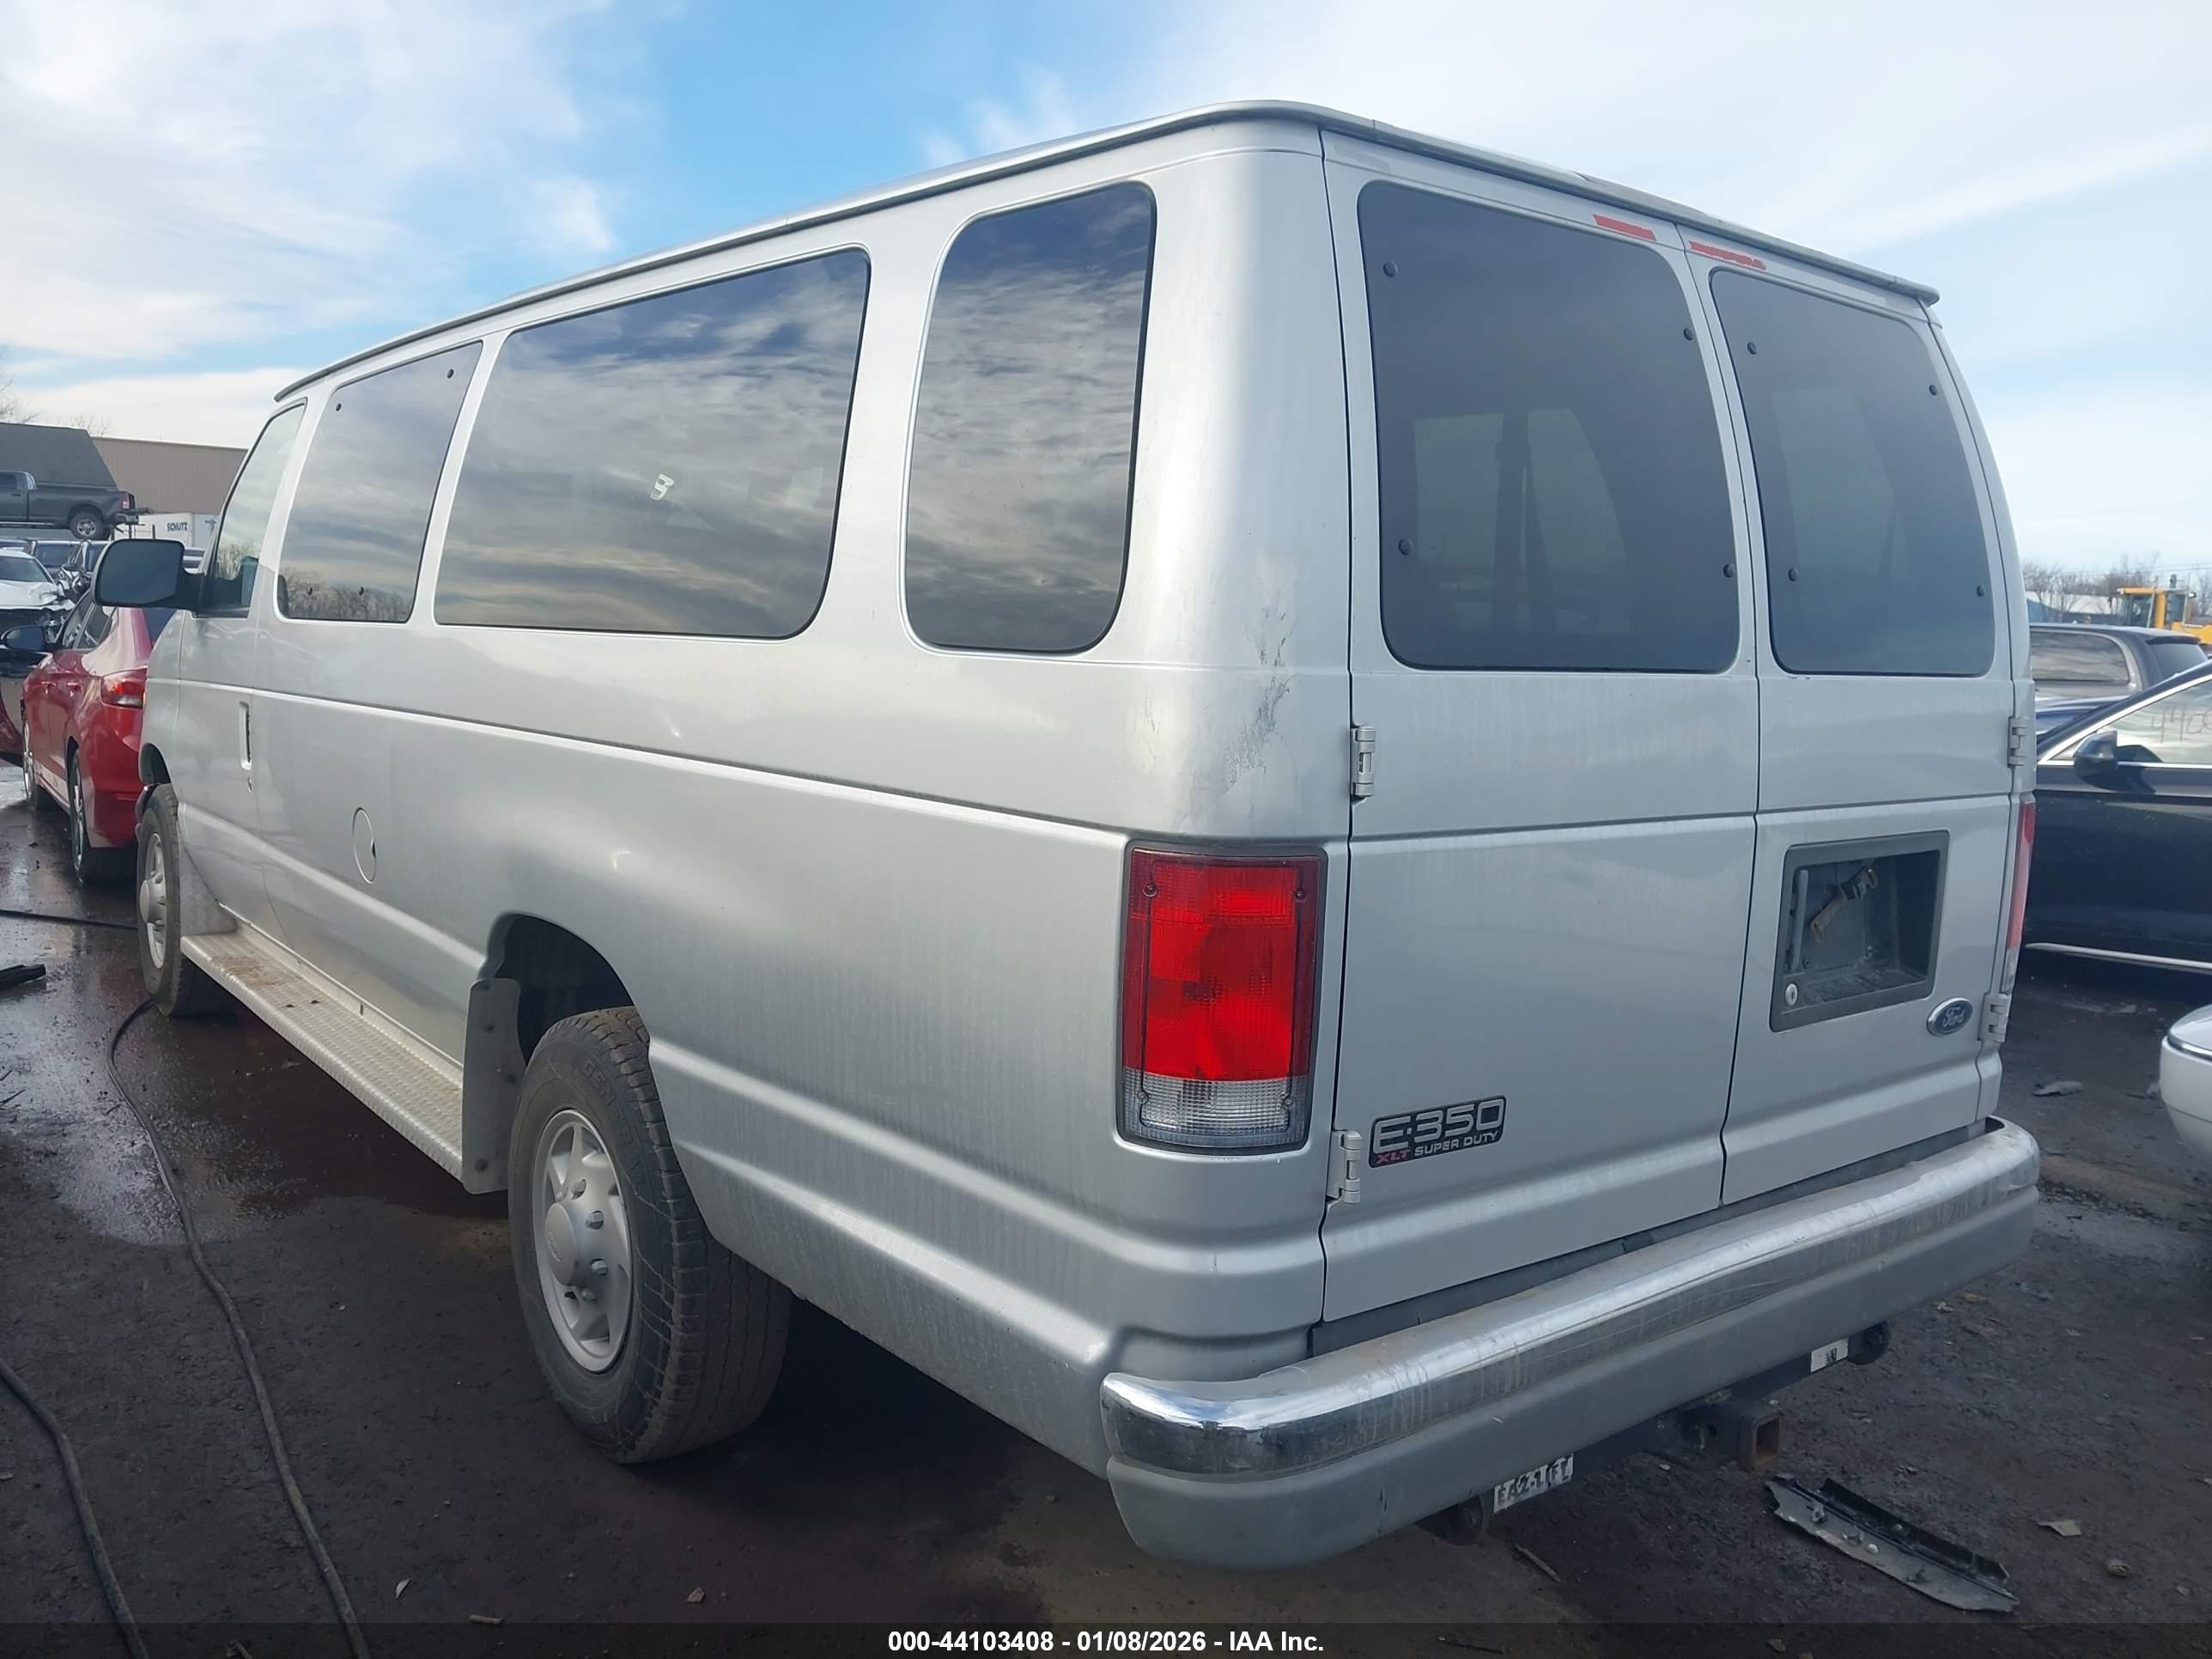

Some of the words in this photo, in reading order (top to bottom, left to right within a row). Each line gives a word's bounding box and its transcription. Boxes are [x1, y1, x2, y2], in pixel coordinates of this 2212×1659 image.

[1942, 1006, 1966, 1028] Ford
[1373, 1098, 1504, 1153] E-350
[1376, 1148, 1410, 1164] XLT
[1414, 1138, 1460, 1157] SUPER
[1463, 1130, 1498, 1146] DUTY
